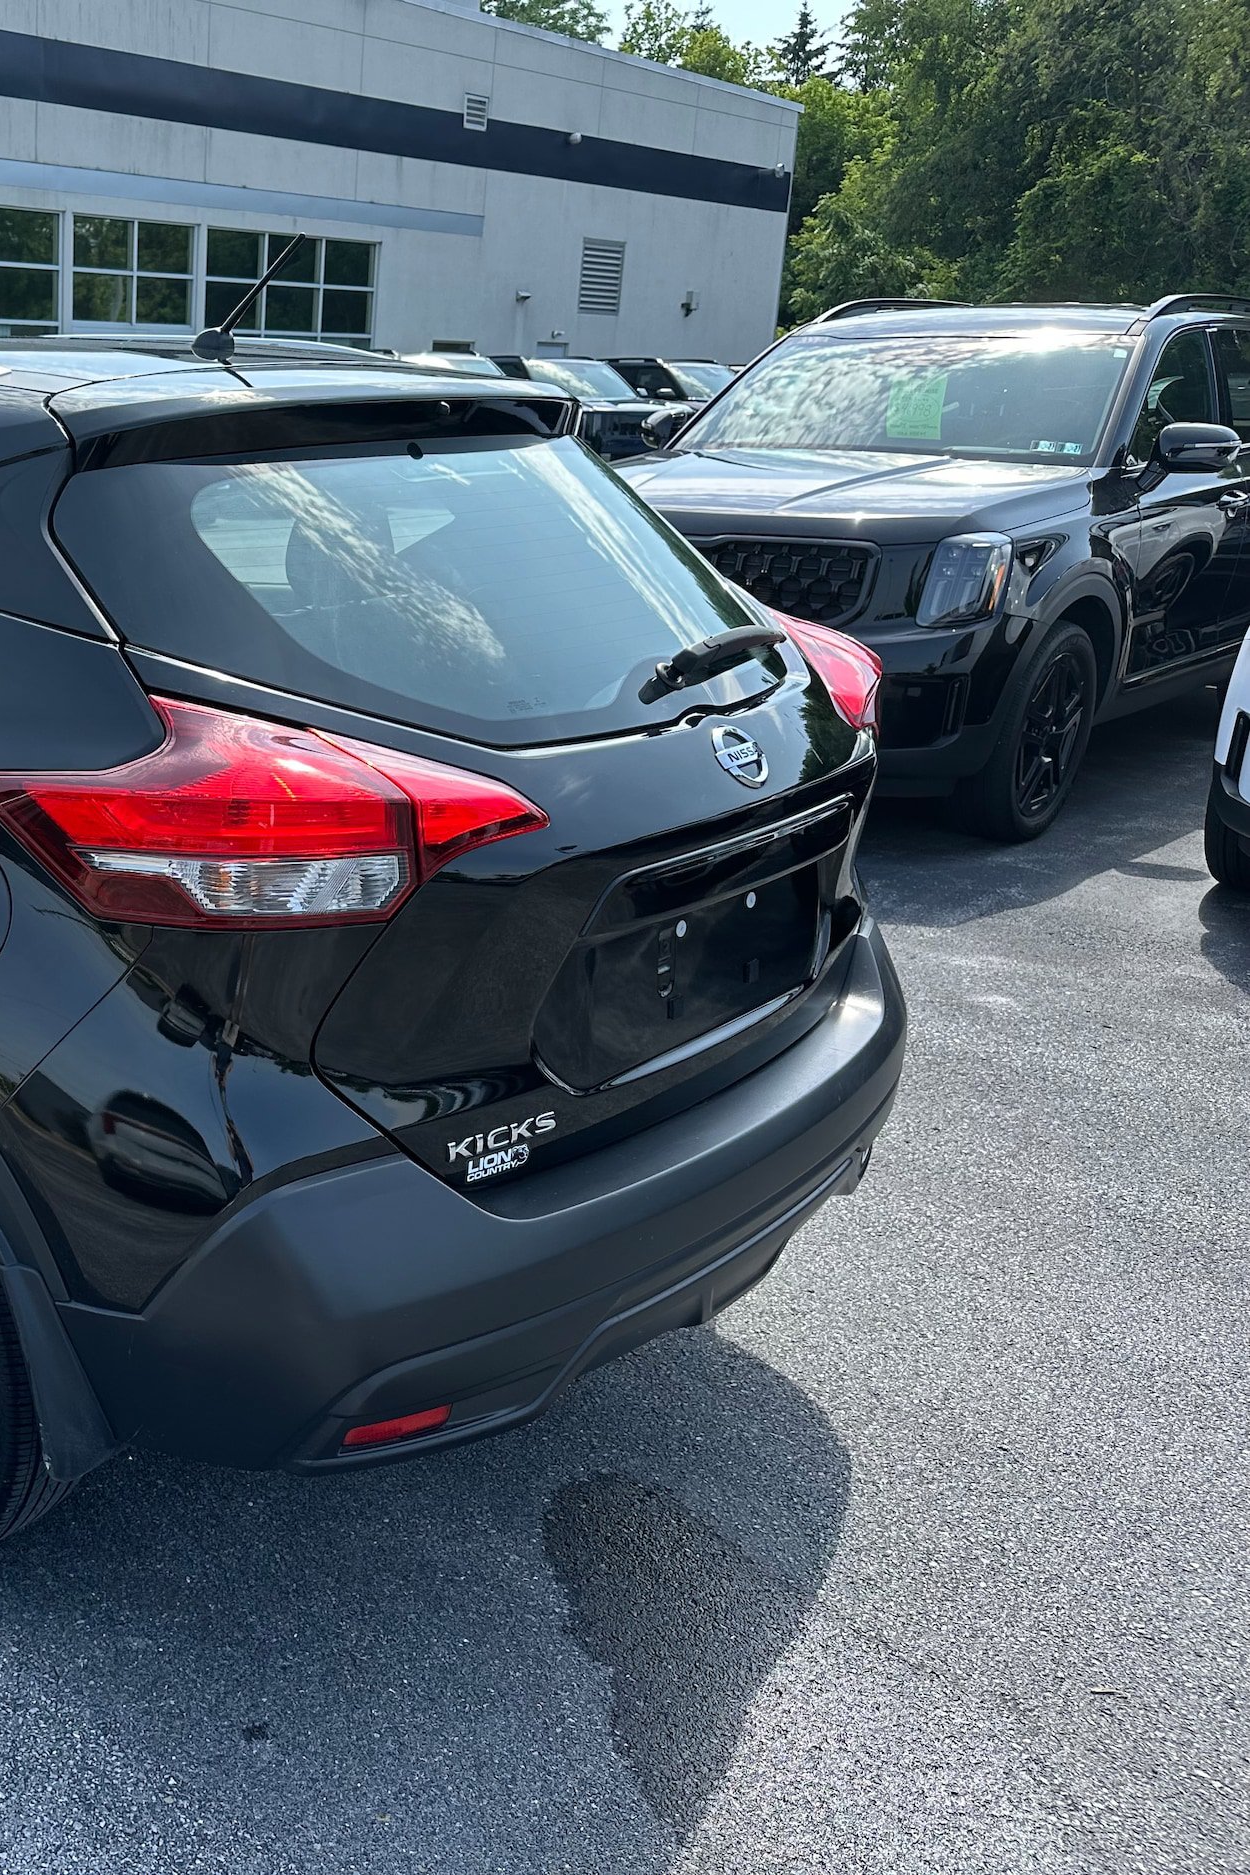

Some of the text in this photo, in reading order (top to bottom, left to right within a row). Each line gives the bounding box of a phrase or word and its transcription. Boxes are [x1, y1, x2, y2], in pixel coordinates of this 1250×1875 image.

[727, 742, 759, 763] NISS
[447, 1111, 557, 1163] KICKS
[466, 1160, 518, 1182] COUNTRY
[468, 1148, 512, 1174] LION
